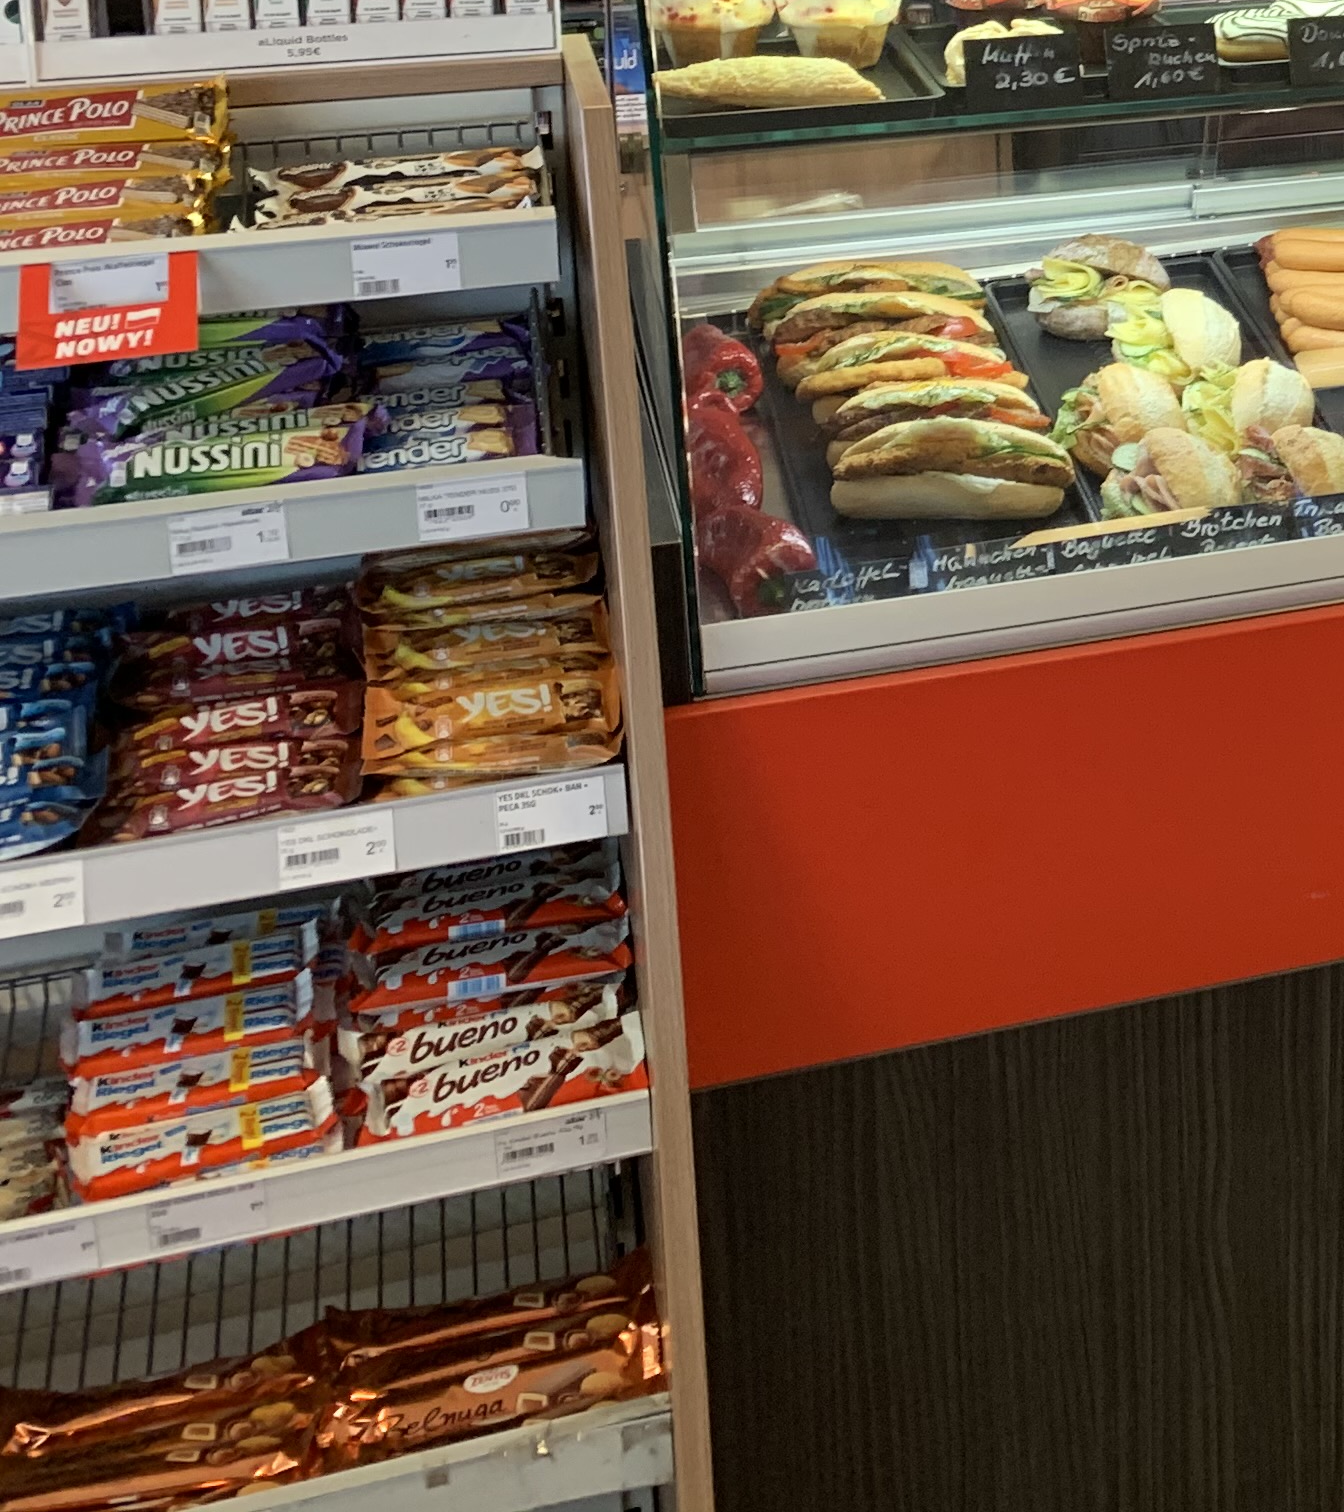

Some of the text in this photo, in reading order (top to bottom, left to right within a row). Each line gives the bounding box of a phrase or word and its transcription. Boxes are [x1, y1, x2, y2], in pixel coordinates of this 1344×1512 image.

[54, 313, 122, 338] NEU!
[54, 329, 154, 359] NOWY!
[409, 1016, 518, 1064] bueno
[432, 1049, 540, 1104] bueno
